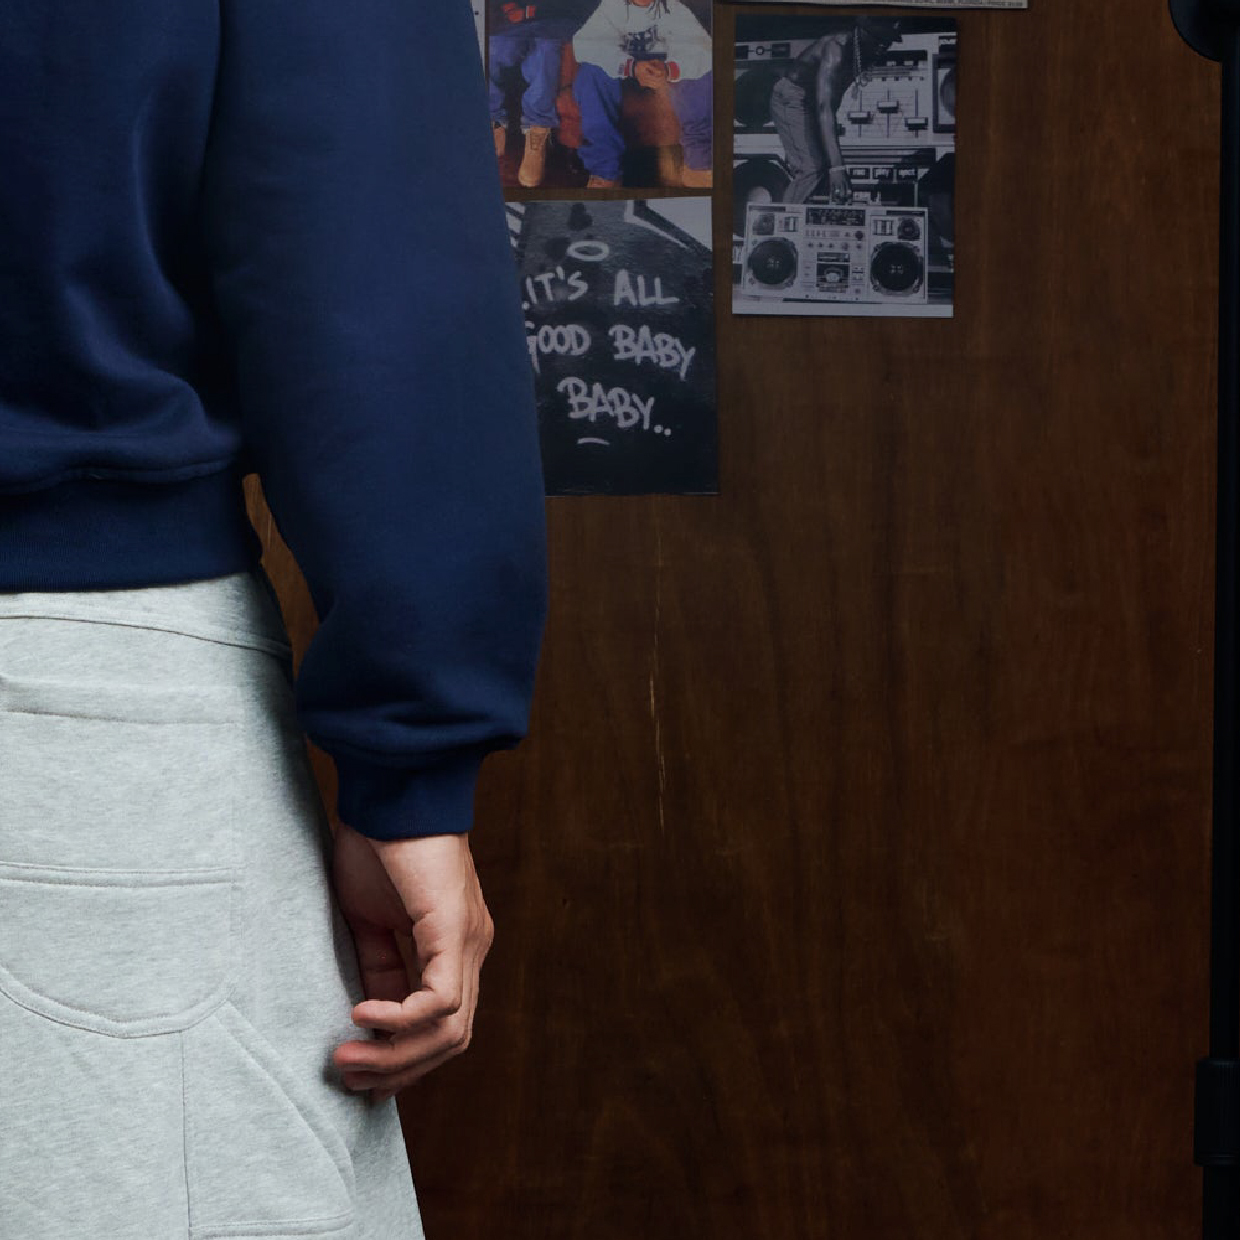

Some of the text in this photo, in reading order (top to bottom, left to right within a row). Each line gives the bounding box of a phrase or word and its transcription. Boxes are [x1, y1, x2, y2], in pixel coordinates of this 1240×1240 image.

[525, 266, 680, 307] IT'S ALL
[609, 324, 696, 382] BABY
